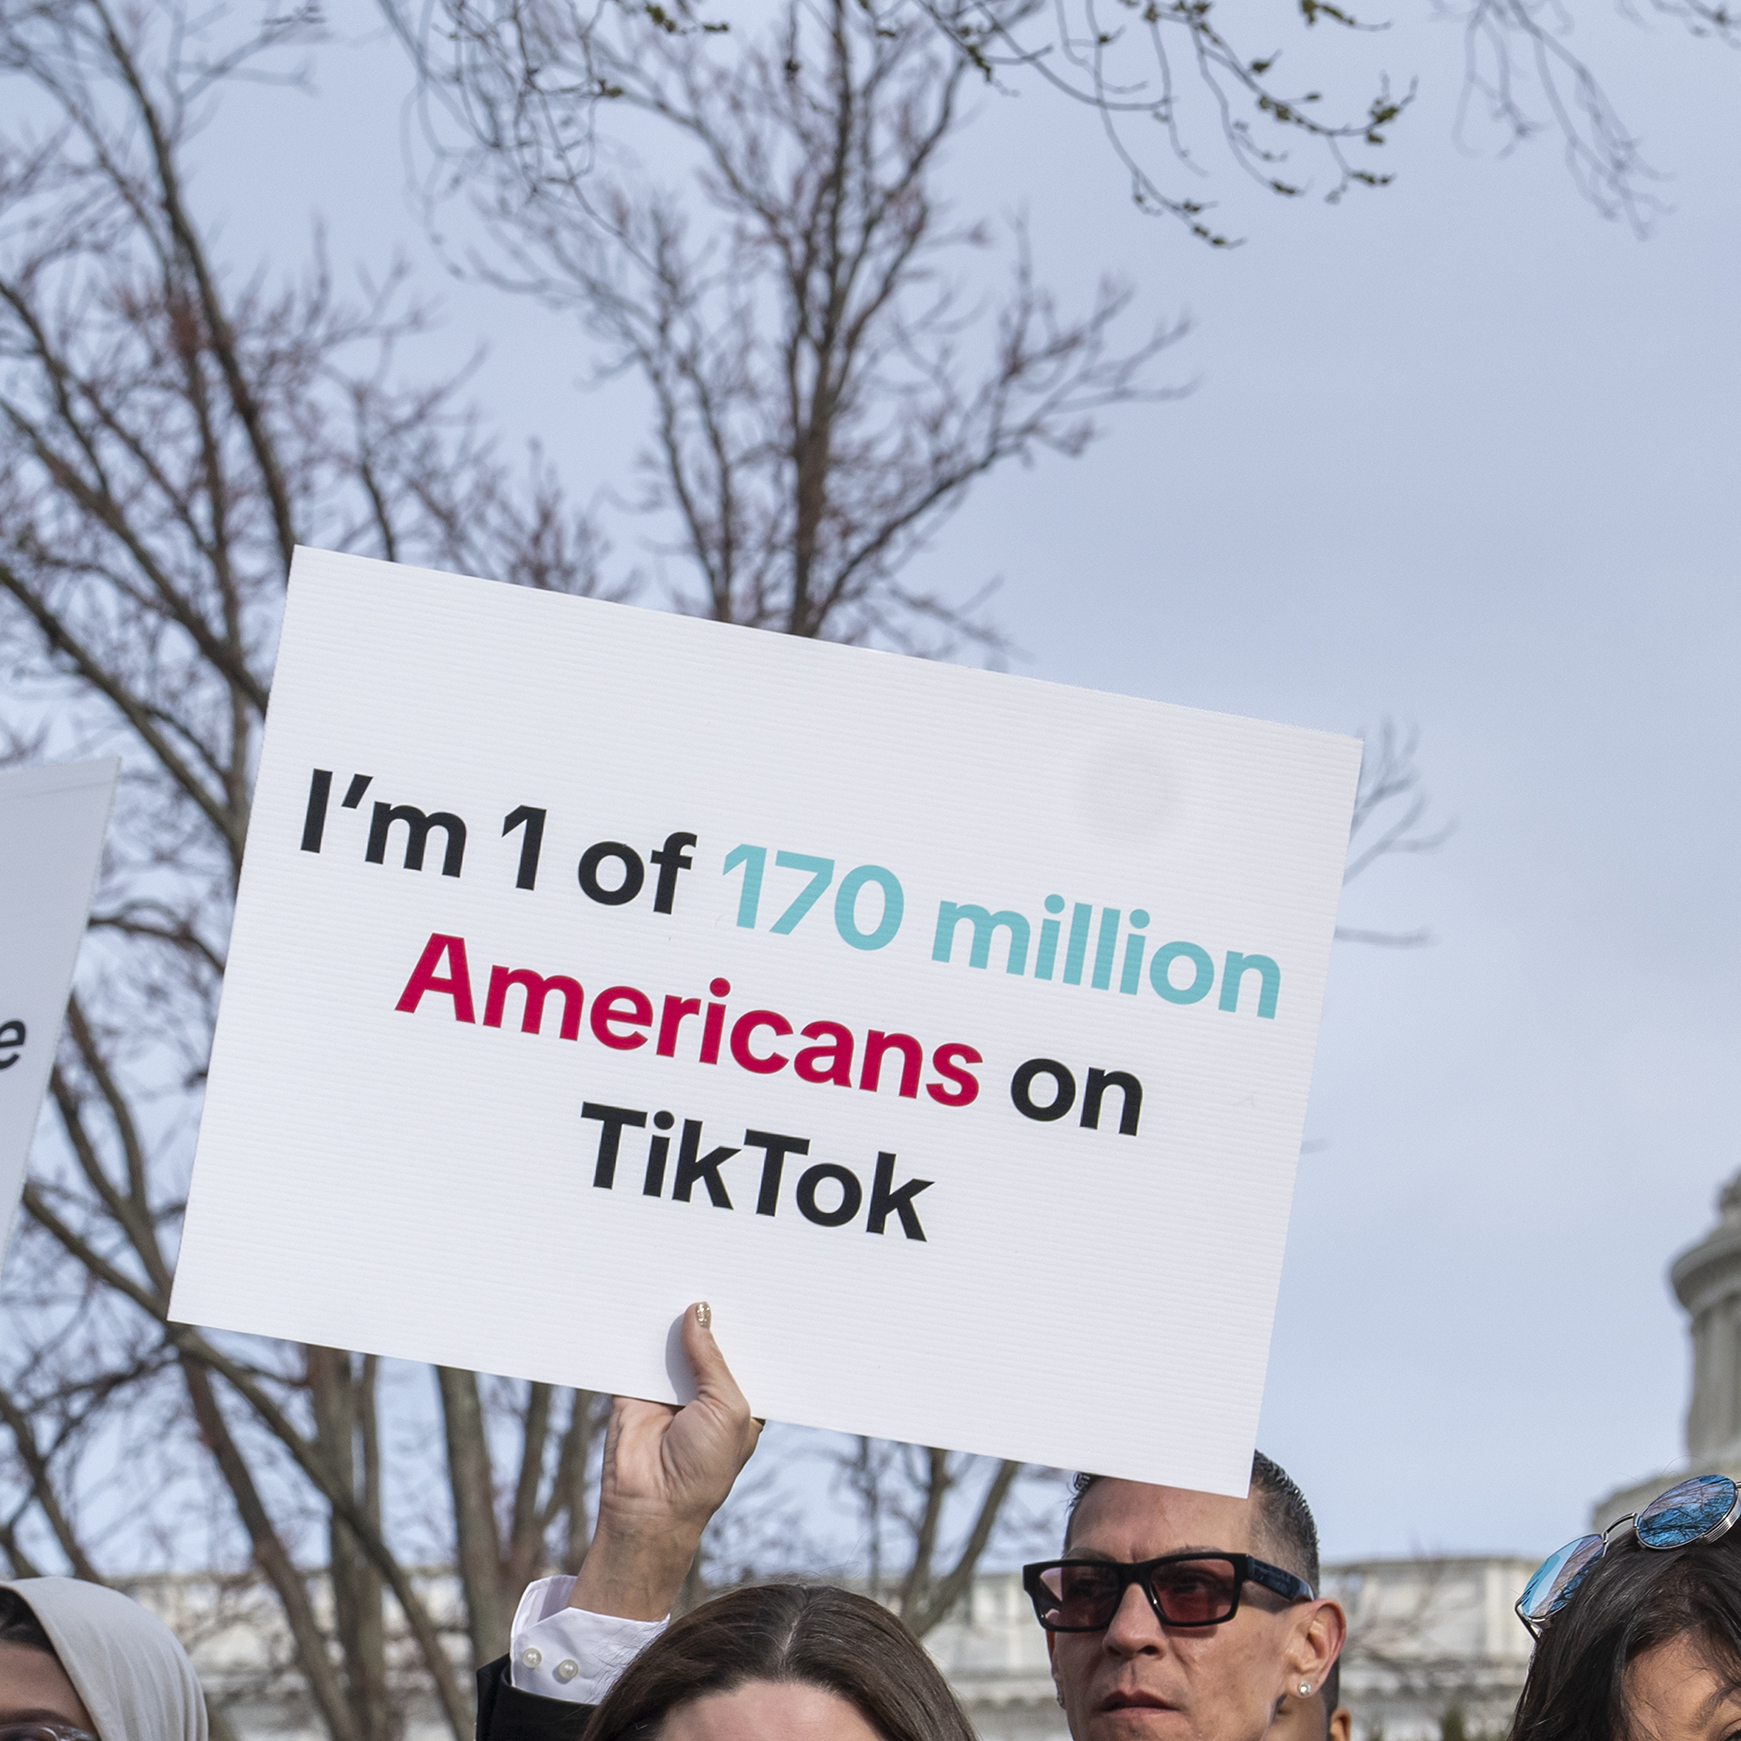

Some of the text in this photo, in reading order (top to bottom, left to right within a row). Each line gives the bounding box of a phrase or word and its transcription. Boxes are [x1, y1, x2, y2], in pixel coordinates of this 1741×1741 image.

[299, 767, 1281, 1020] I'm 1 of 170 million
[393, 931, 1144, 1138] Americans on
[579, 1100, 936, 1243] TikTok
